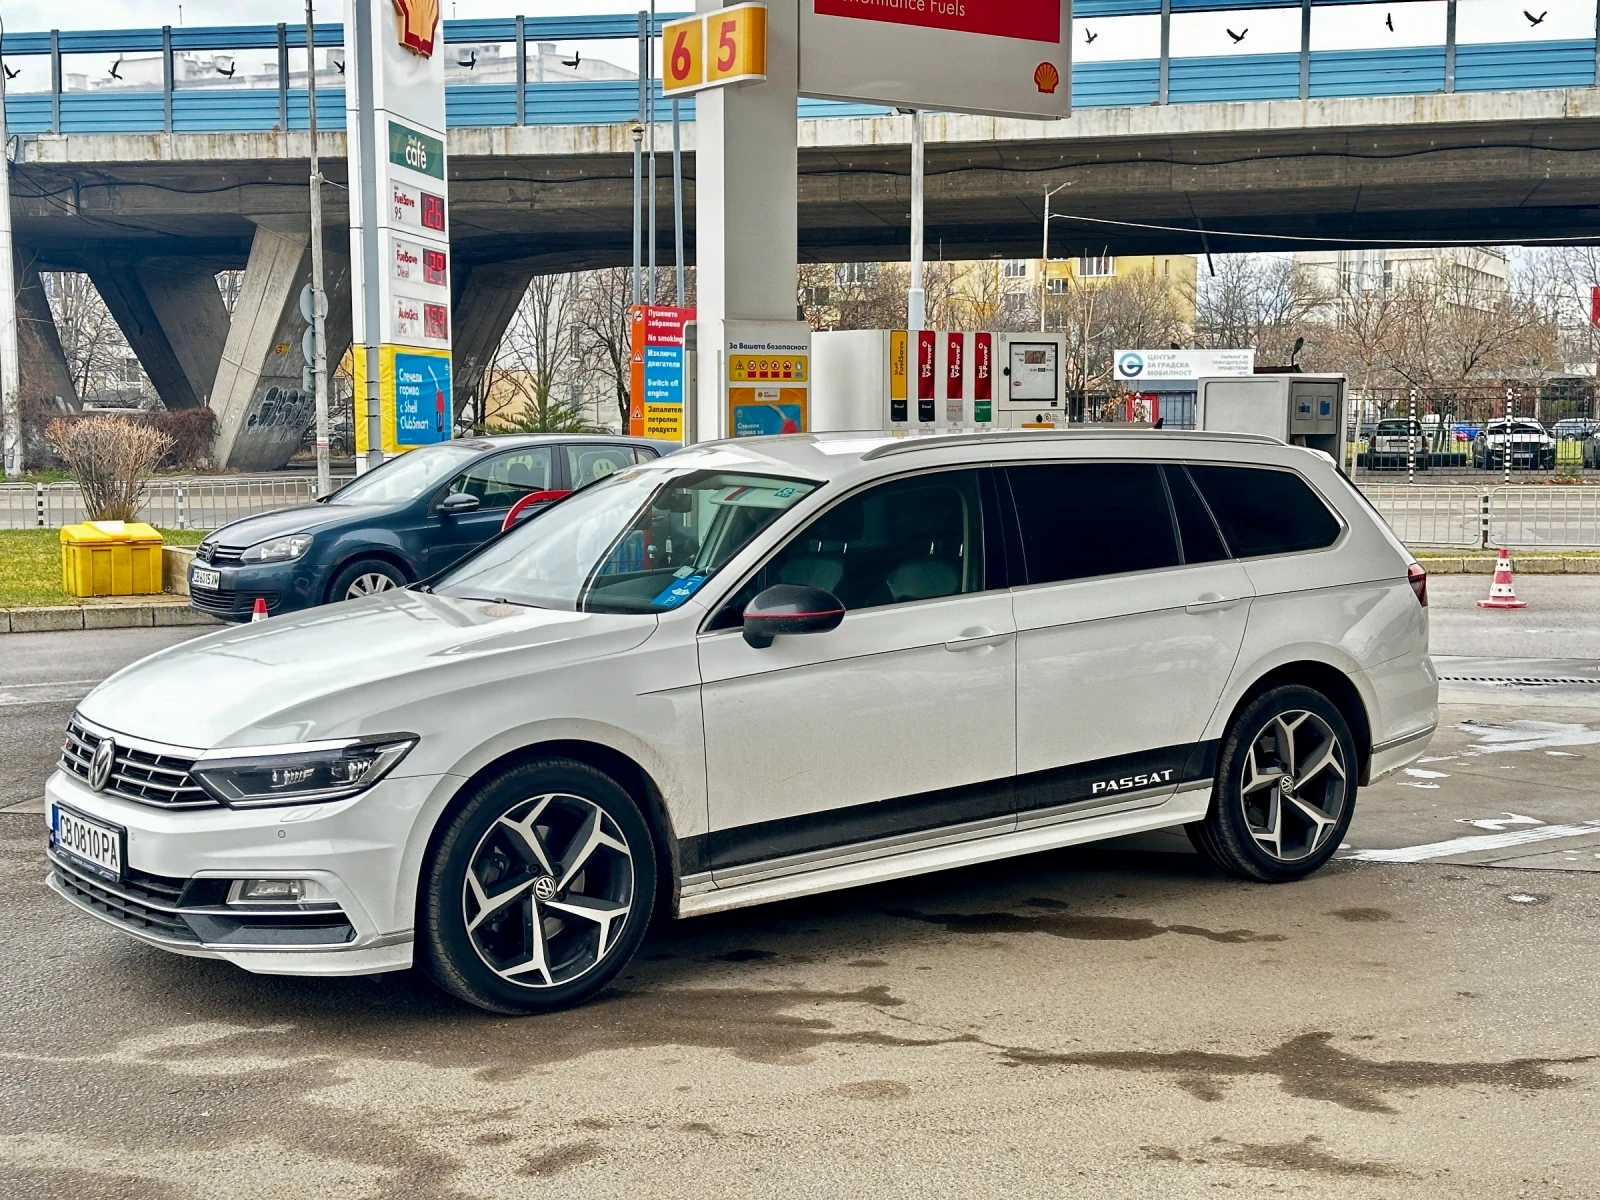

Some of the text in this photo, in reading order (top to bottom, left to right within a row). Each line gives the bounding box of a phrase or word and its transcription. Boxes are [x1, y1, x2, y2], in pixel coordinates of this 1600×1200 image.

[930, 0, 965, 17] Fuels
[671, 19, 737, 81] 6 5
[406, 141, 427, 170] café
[393, 191, 415, 208] FuelSave
[394, 206, 402, 220] 95
[396, 249, 418, 264] FuelSave
[648, 309, 678, 319] Пушенето
[648, 320, 681, 329] забранено
[647, 334, 683, 345] No smoking
[729, 342, 808, 351] За Вашата безопасност
[647, 349, 677, 358] Изключи
[647, 361, 681, 369] двигателя
[1157, 362, 1190, 370] ГРАДСКА
[647, 378, 679, 387] Switch off
[647, 390, 669, 399] engine
[404, 399, 418, 414] Shell
[400, 415, 429, 430] ClubSmart
[647, 416, 678, 425] петролни
[647, 426, 678, 435] продукти
[1092, 769, 1174, 794] PASSAT
